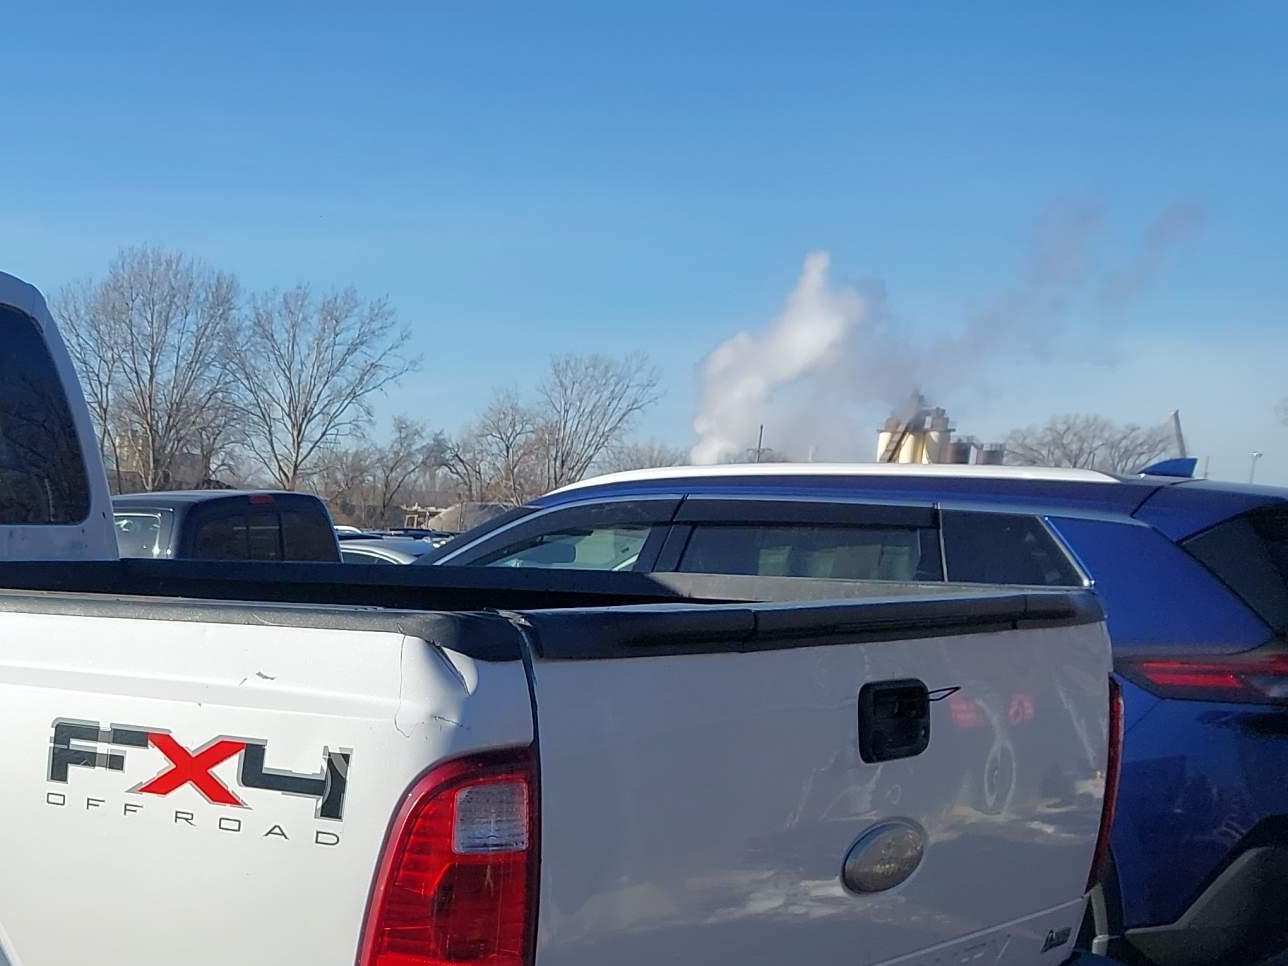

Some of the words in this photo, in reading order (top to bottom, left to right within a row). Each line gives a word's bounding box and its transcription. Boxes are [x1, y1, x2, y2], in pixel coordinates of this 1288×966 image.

[46, 716, 354, 822] FX4
[46, 792, 143, 817] OFF
[174, 810, 341, 847] ROAD
